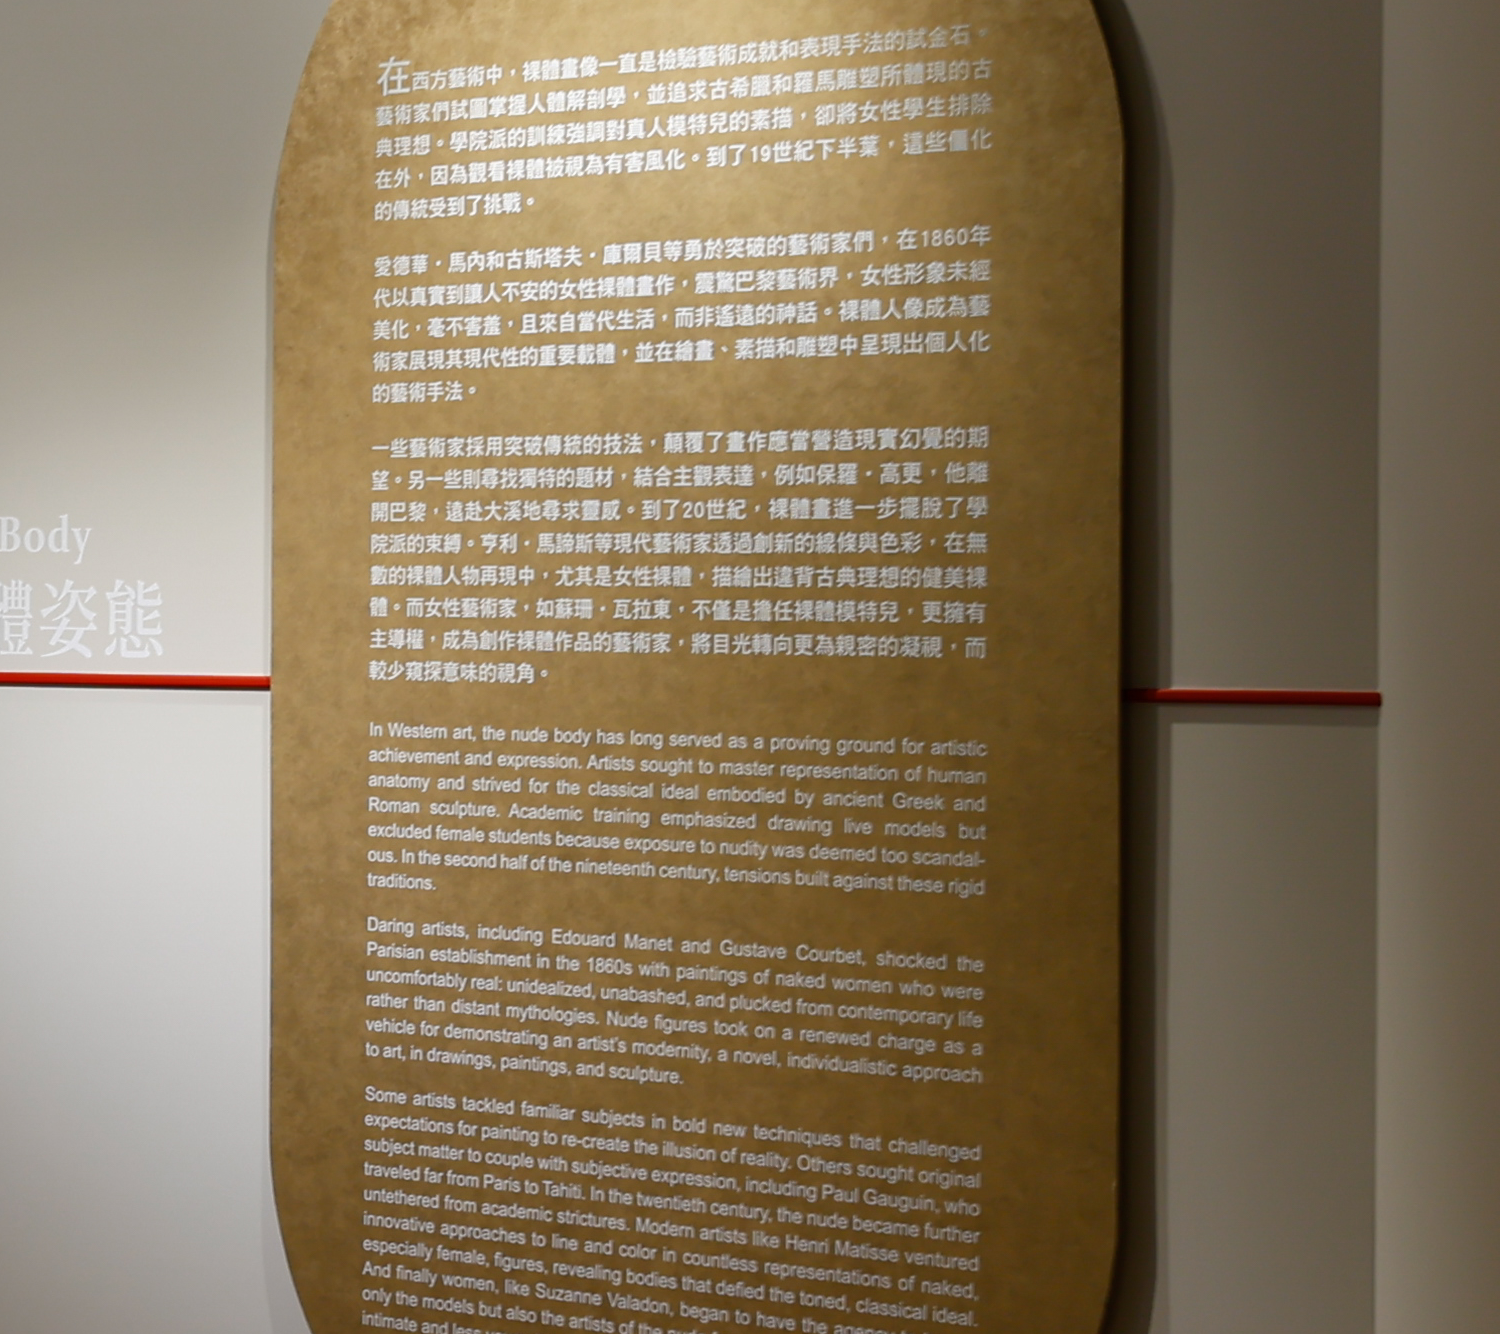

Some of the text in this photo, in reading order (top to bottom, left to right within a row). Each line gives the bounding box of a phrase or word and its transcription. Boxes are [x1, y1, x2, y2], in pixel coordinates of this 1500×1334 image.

[369, 721, 989, 758] In Western art, the nude body has long served as a proving ground for artistic
[366, 915, 986, 974] Daring artists, including Edouard Manet and Gustave Courbet, shocked the
[366, 940, 985, 1001] Parisian establishment in the 1860s with paintings of naked women who were
[363, 1113, 982, 1190] expectations for painting to re-create the illusion of reality. Others sought original
